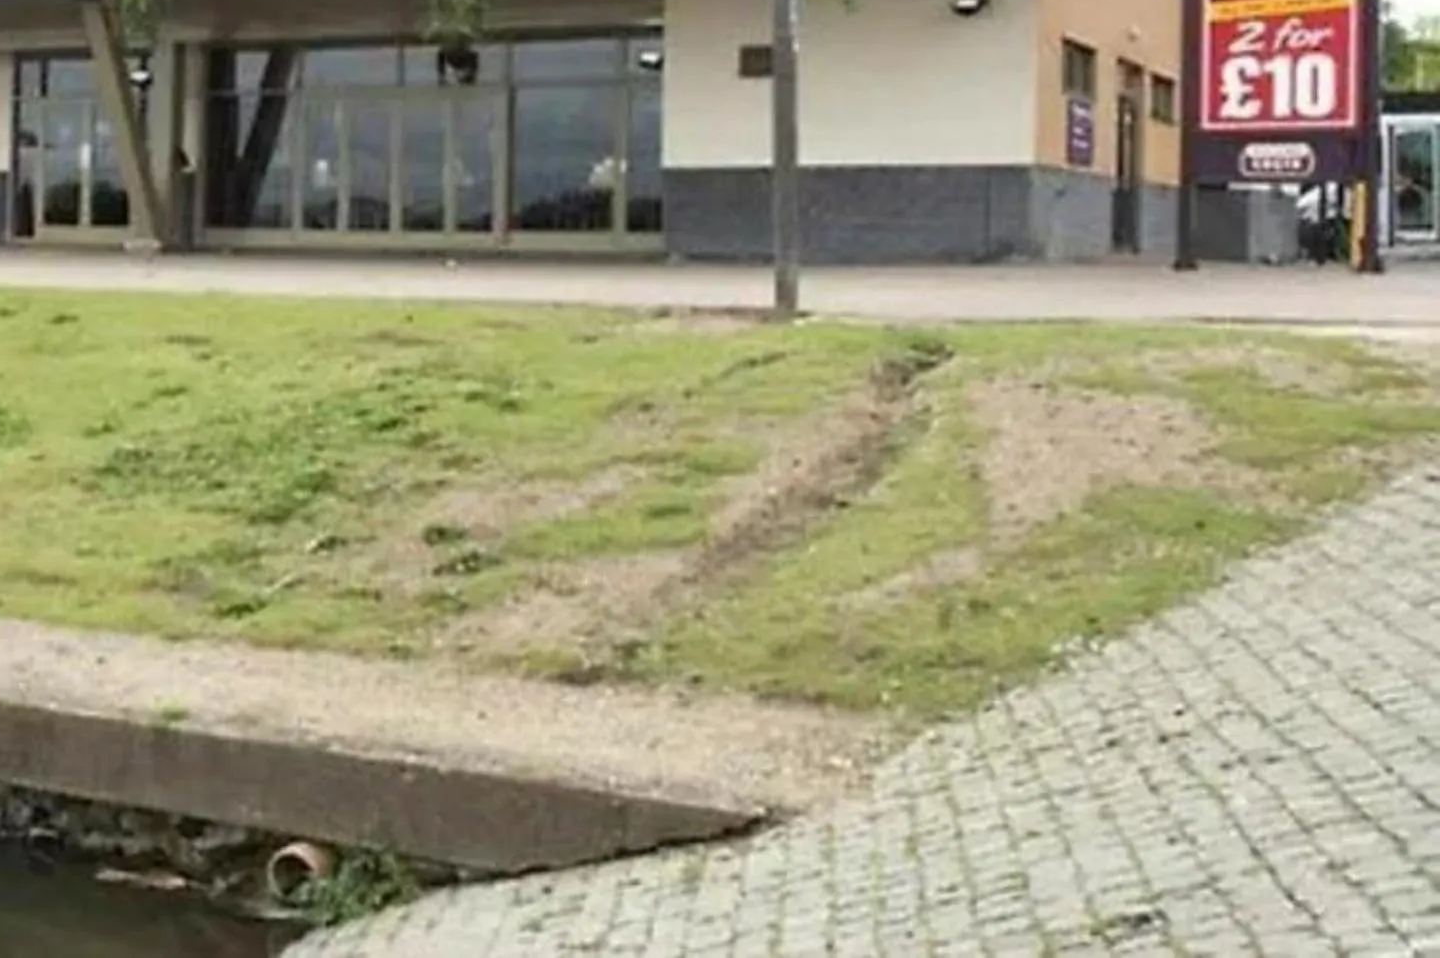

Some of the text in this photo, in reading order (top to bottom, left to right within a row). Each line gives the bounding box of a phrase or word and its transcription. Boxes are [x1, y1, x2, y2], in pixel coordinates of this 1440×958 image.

[1227, 16, 1335, 53] 2 for
[1219, 53, 1337, 119] £10
